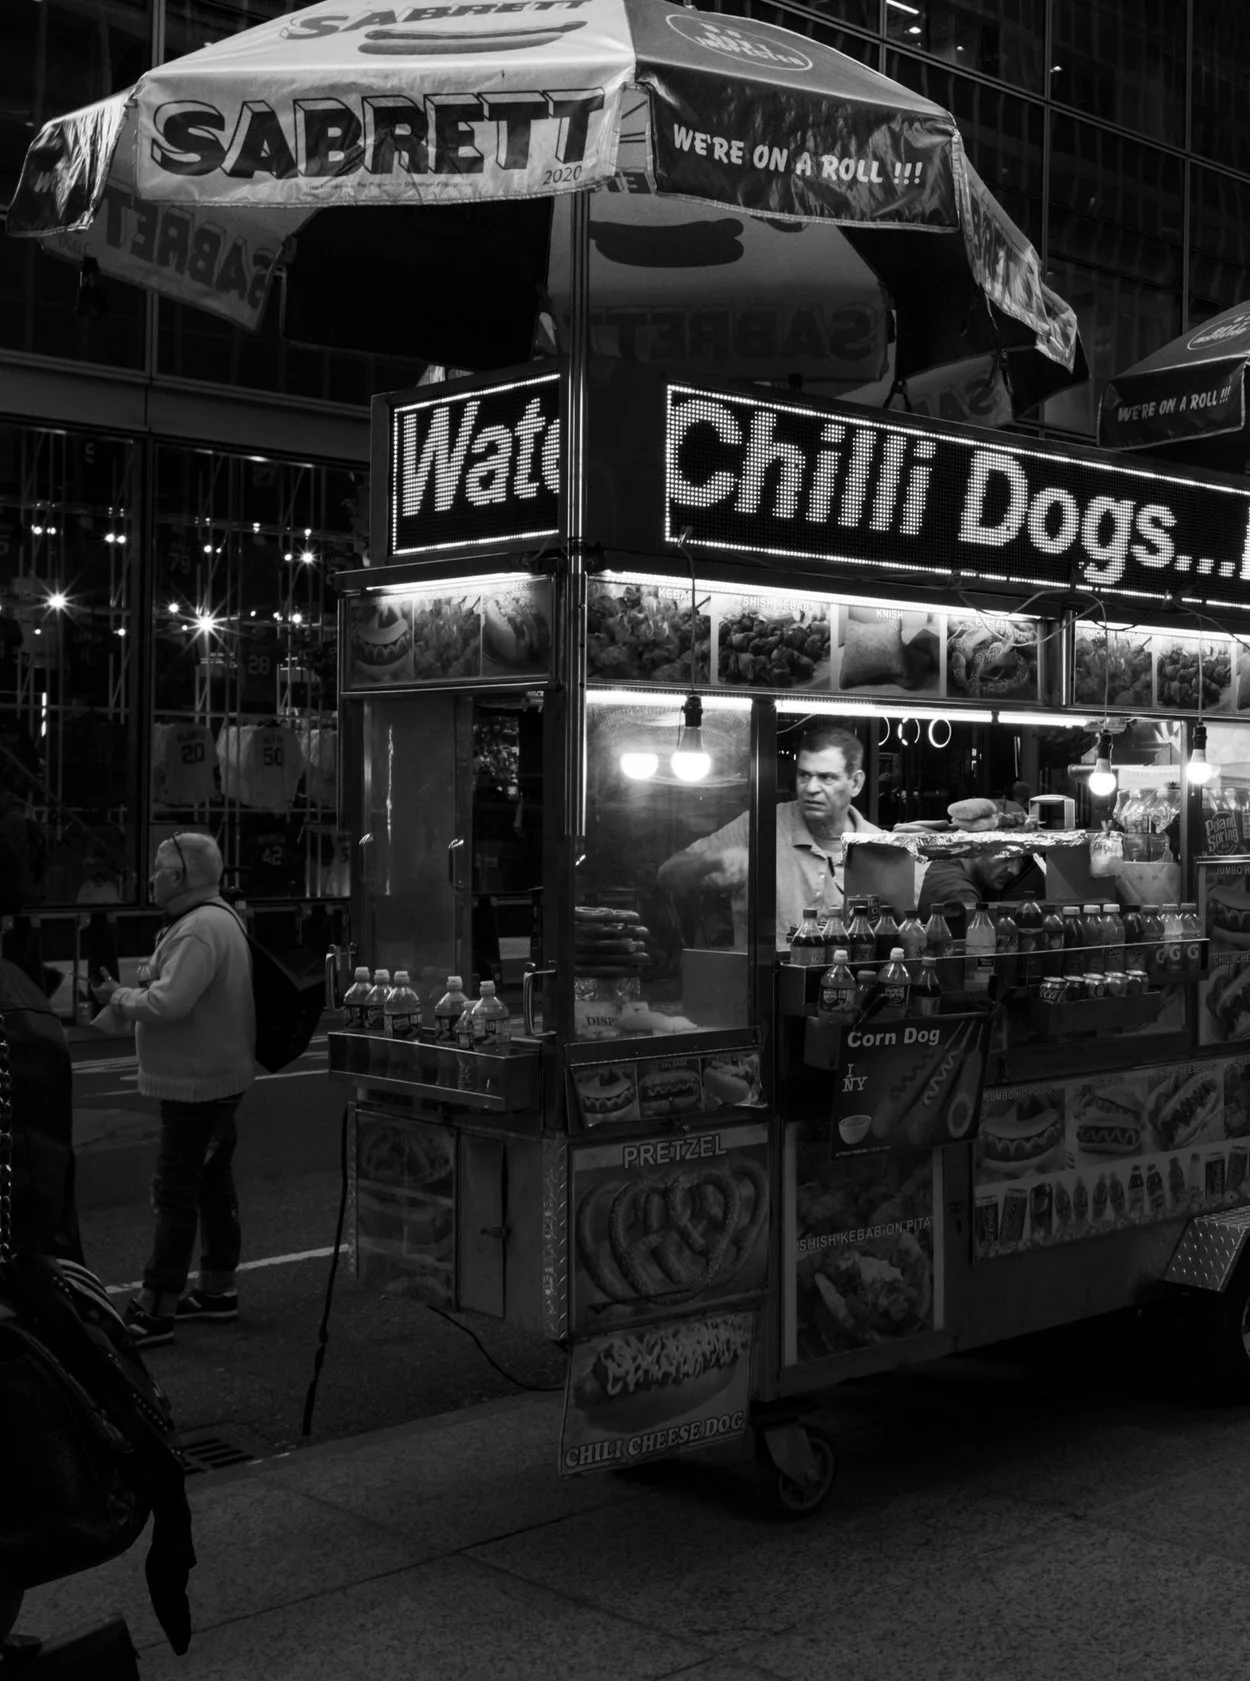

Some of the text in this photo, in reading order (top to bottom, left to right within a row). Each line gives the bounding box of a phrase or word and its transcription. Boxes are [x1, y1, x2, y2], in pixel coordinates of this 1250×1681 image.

[280, 0, 592, 40] SABRETT
[152, 87, 605, 179] SABRETT
[672, 123, 924, 186] WE'RE ON A ROLL !!!
[543, 165, 583, 186] 2020
[1159, 397, 1176, 416] ON
[1179, 395, 1188, 412] A
[1190, 390, 1218, 411] ROLL
[669, 397, 937, 536] Chilli
[876, 608, 904, 620] KNISH
[181, 742, 206, 765] 20
[263, 747, 284, 766] 50
[1208, 828, 1239, 852] Spring
[1216, 865, 1242, 876] JUMBO
[1169, 944, 1181, 961] G
[1187, 943, 1200, 960] G
[847, 1027, 941, 1049] Corn Dog
[845, 1063, 855, 1078] I
[841, 1075, 868, 1093] NY
[623, 1134, 728, 1169] PRETZEL
[799, 1216, 931, 1252] SHISH KEBAB ON PITA
[564, 1413, 744, 1468] CHILI CHEESE DOG
